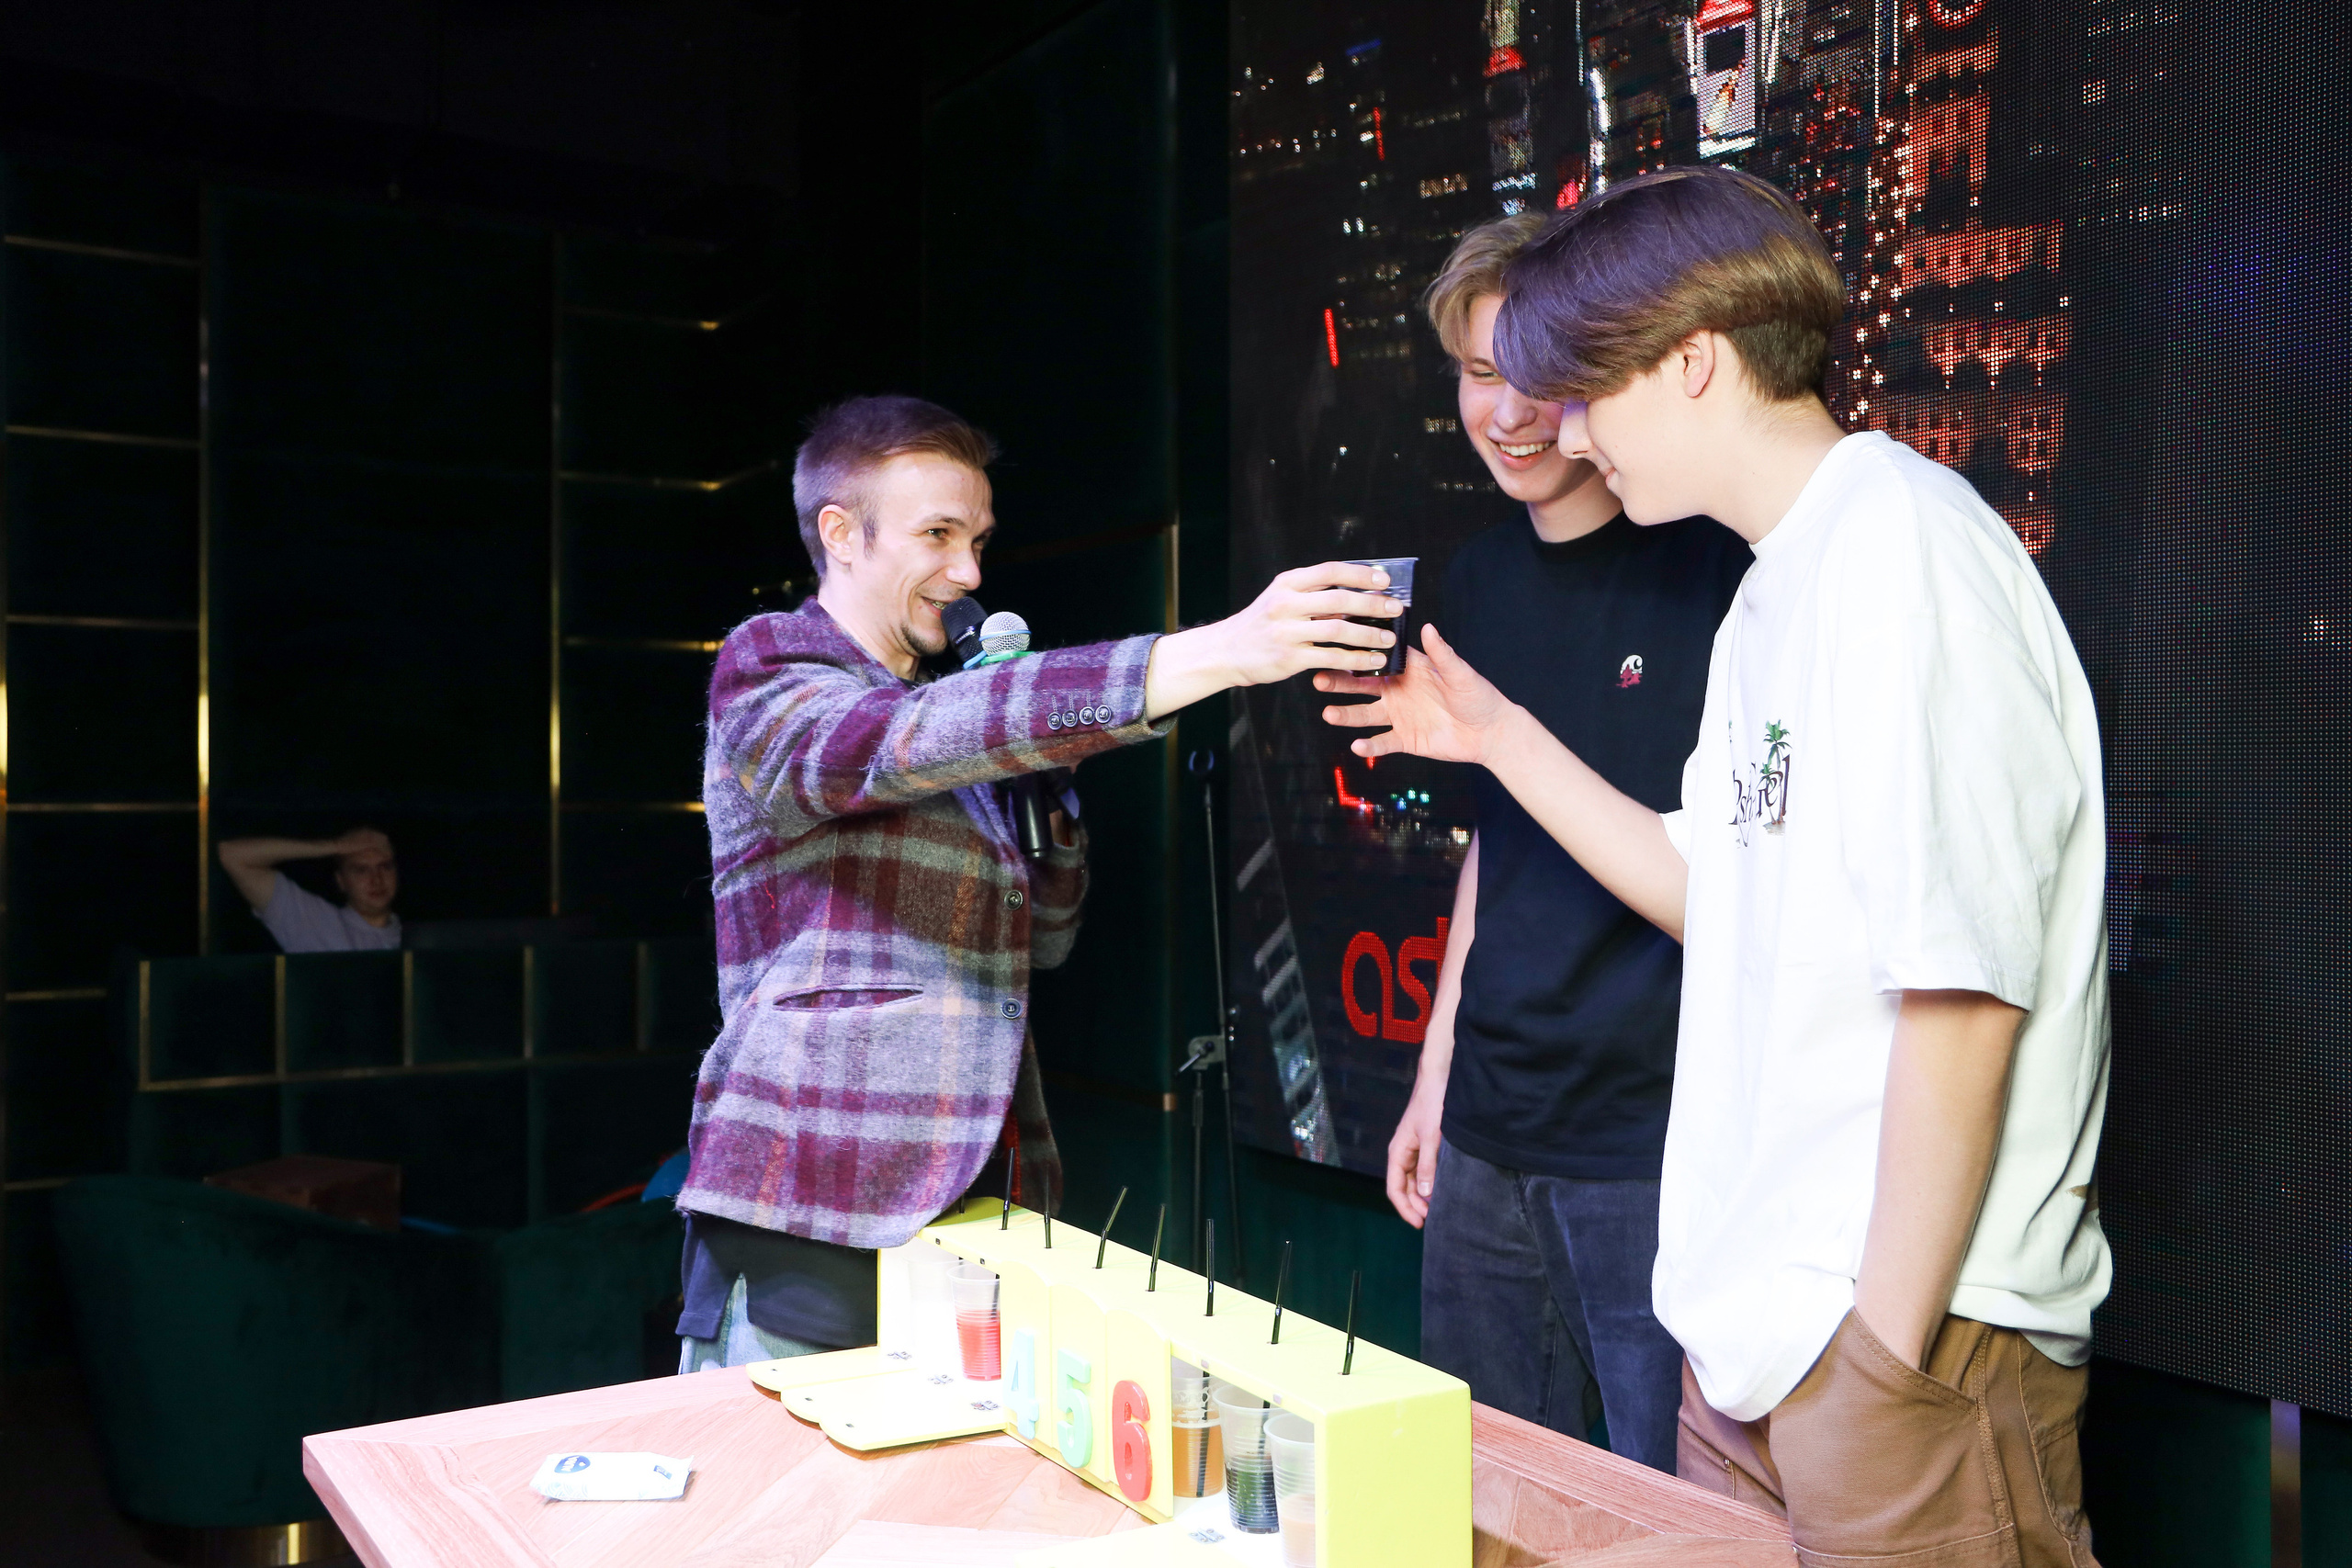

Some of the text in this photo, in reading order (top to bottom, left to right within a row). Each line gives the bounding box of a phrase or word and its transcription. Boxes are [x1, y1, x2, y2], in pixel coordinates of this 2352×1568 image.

[1002, 1328, 1153, 1503] 4 5 6
